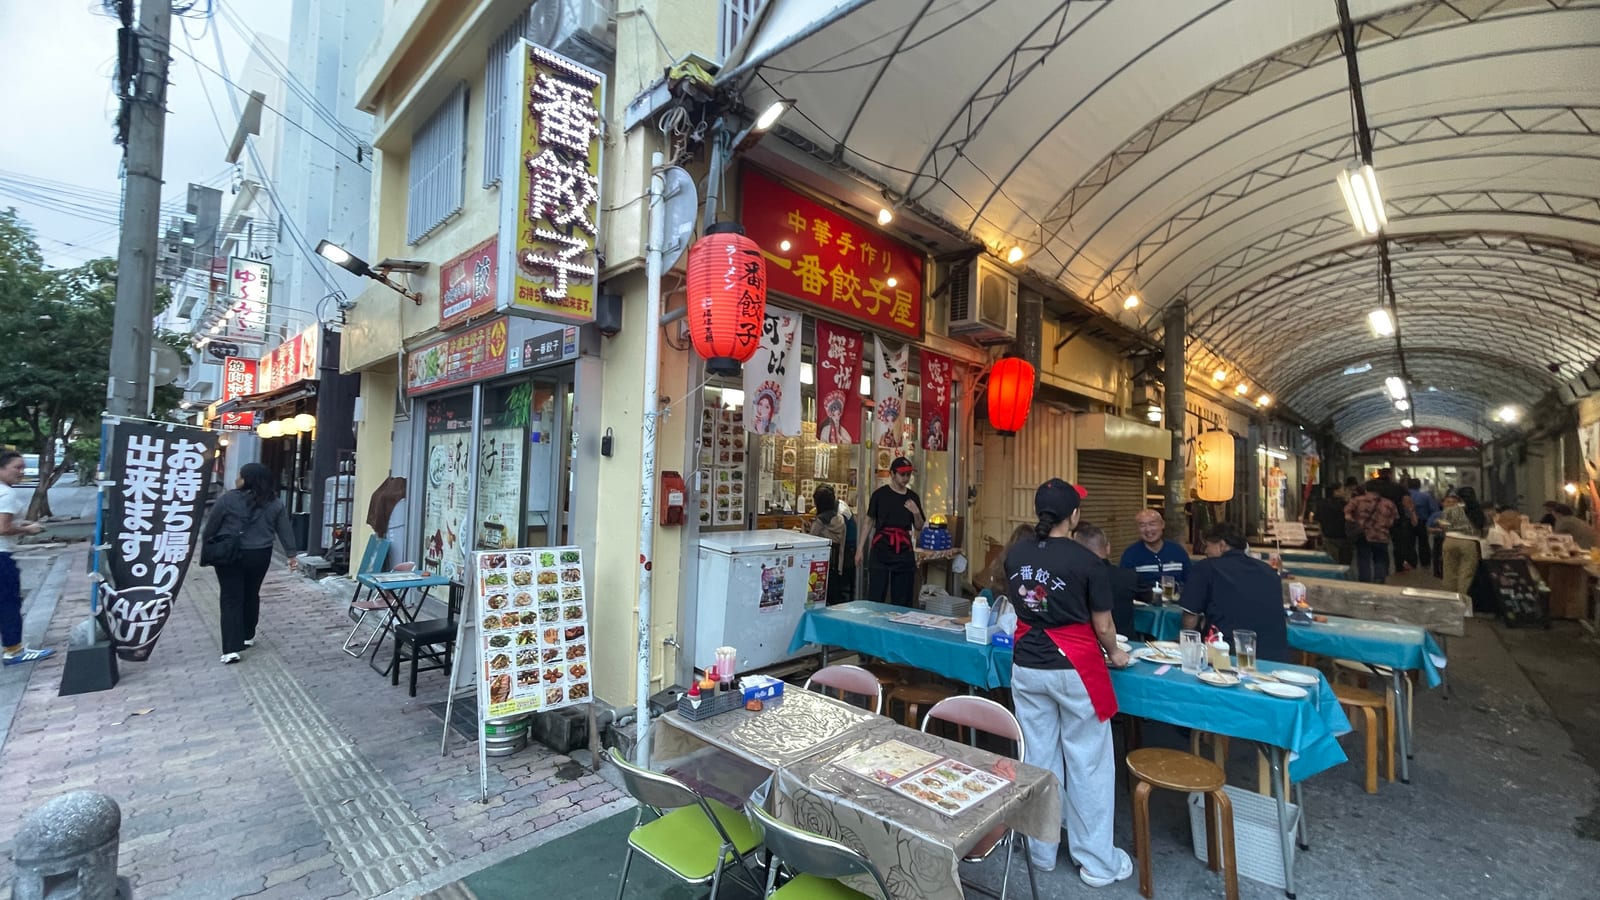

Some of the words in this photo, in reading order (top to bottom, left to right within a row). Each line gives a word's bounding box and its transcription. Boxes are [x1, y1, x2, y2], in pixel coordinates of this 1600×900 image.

[526, 47, 600, 299] 一番餃子
[723, 244, 738, 291] ラーメン
[787, 209, 892, 274] 中華手作り
[735, 250, 763, 347] 一番餃子
[760, 249, 915, 328] 一番餃子屋
[118, 435, 164, 578] 出来ます。
[151, 438, 207, 595] お持ち帰り
[100, 582, 173, 622] TAKE
[1010, 564, 1067, 591] 一番餃子
